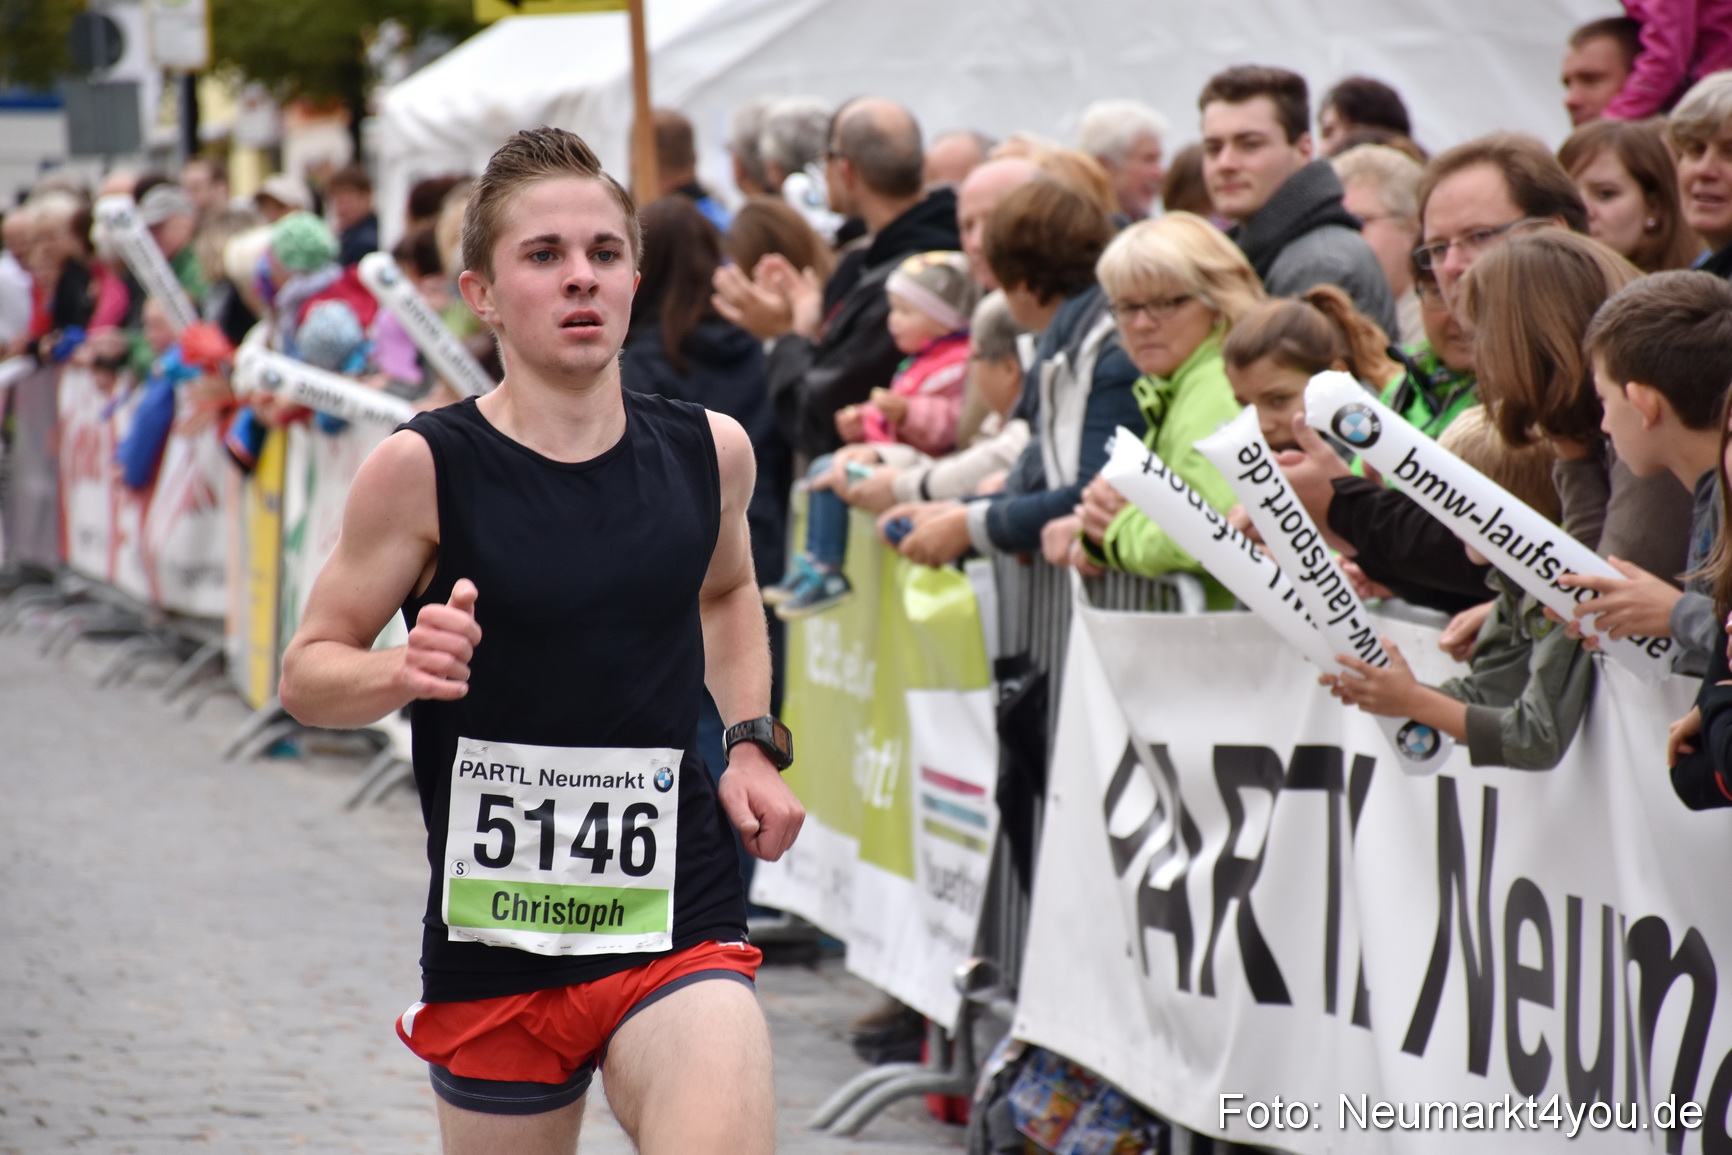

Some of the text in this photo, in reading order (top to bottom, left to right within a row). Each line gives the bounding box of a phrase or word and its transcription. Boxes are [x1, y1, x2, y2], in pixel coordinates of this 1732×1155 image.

[1238, 442, 1391, 668] mw-laufsport.de
[1393, 447, 1672, 659] bmw-laufspode
[459, 760, 645, 789] PARTL Neumarkt
[473, 793, 658, 877] 5146
[456, 862, 465, 876] S
[491, 890, 625, 932] Christoph
